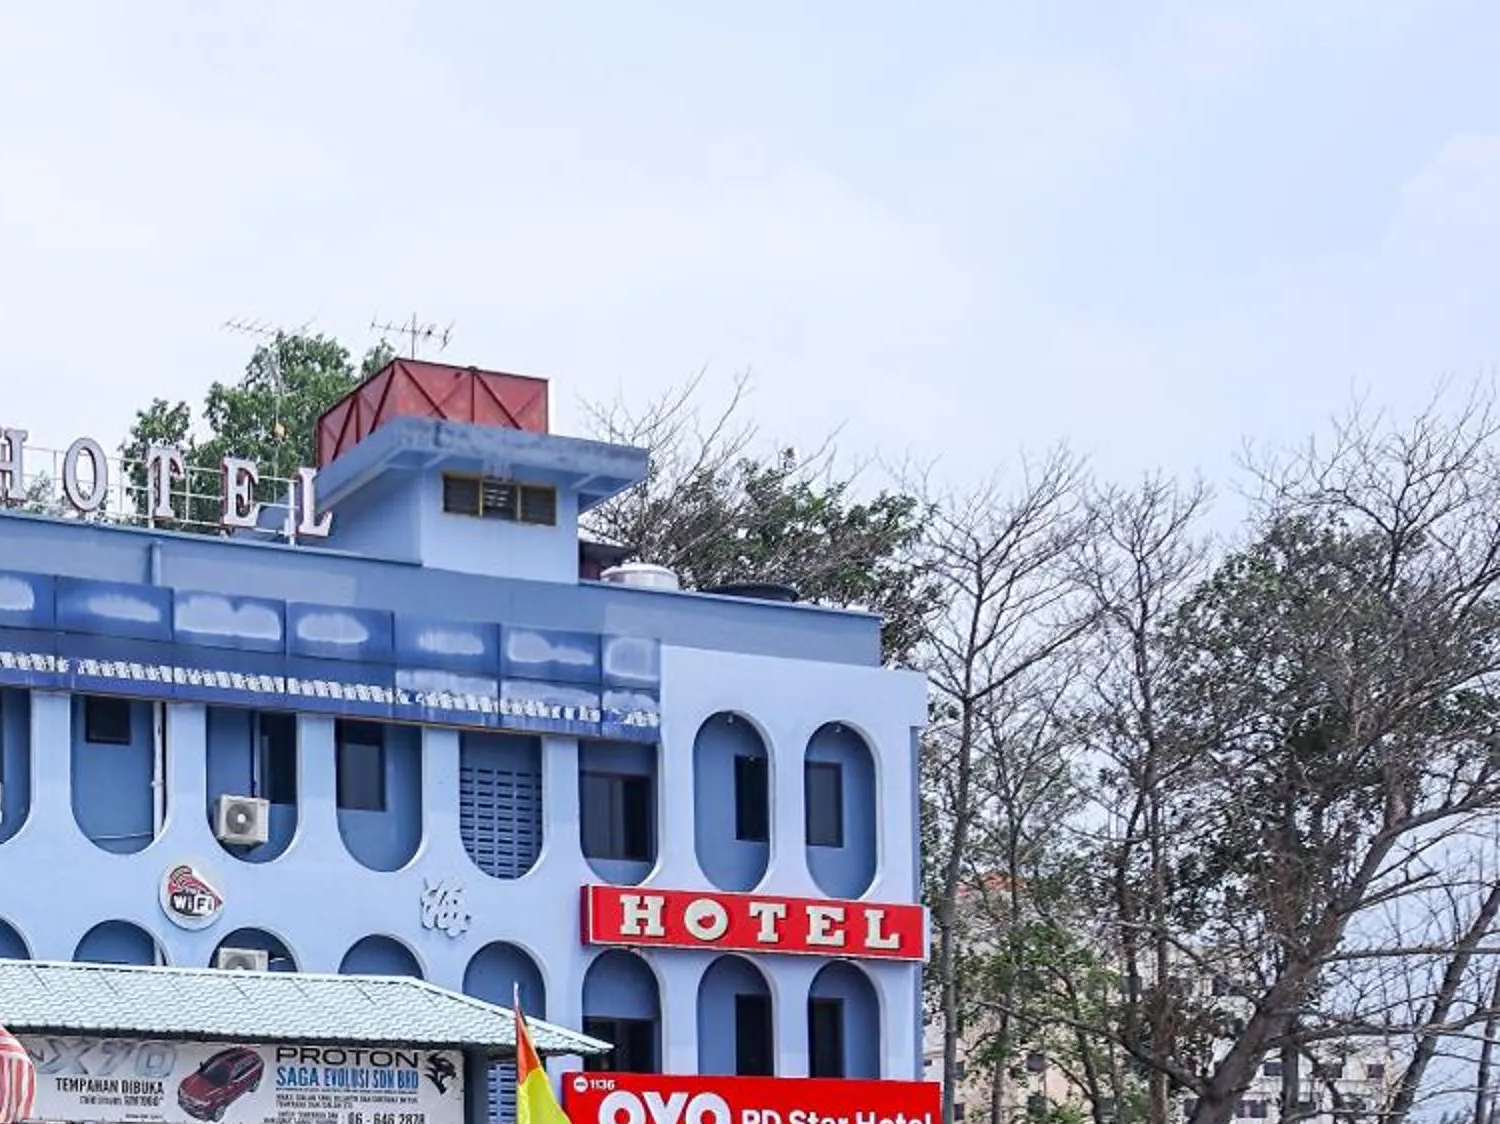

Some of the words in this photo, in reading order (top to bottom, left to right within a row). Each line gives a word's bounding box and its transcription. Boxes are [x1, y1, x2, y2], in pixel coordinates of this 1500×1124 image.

[619, 894, 900, 949] HOTEL
[276, 1047, 419, 1068] PROTON
[56, 1077, 118, 1094] TEMPAHAN
[122, 1079, 164, 1095] DIBUKA
[276, 1066, 320, 1086] SAGA
[324, 1067, 369, 1088] EVOLUSI
[372, 1069, 394, 1088] SDN
[397, 1070, 419, 1089] BHD
